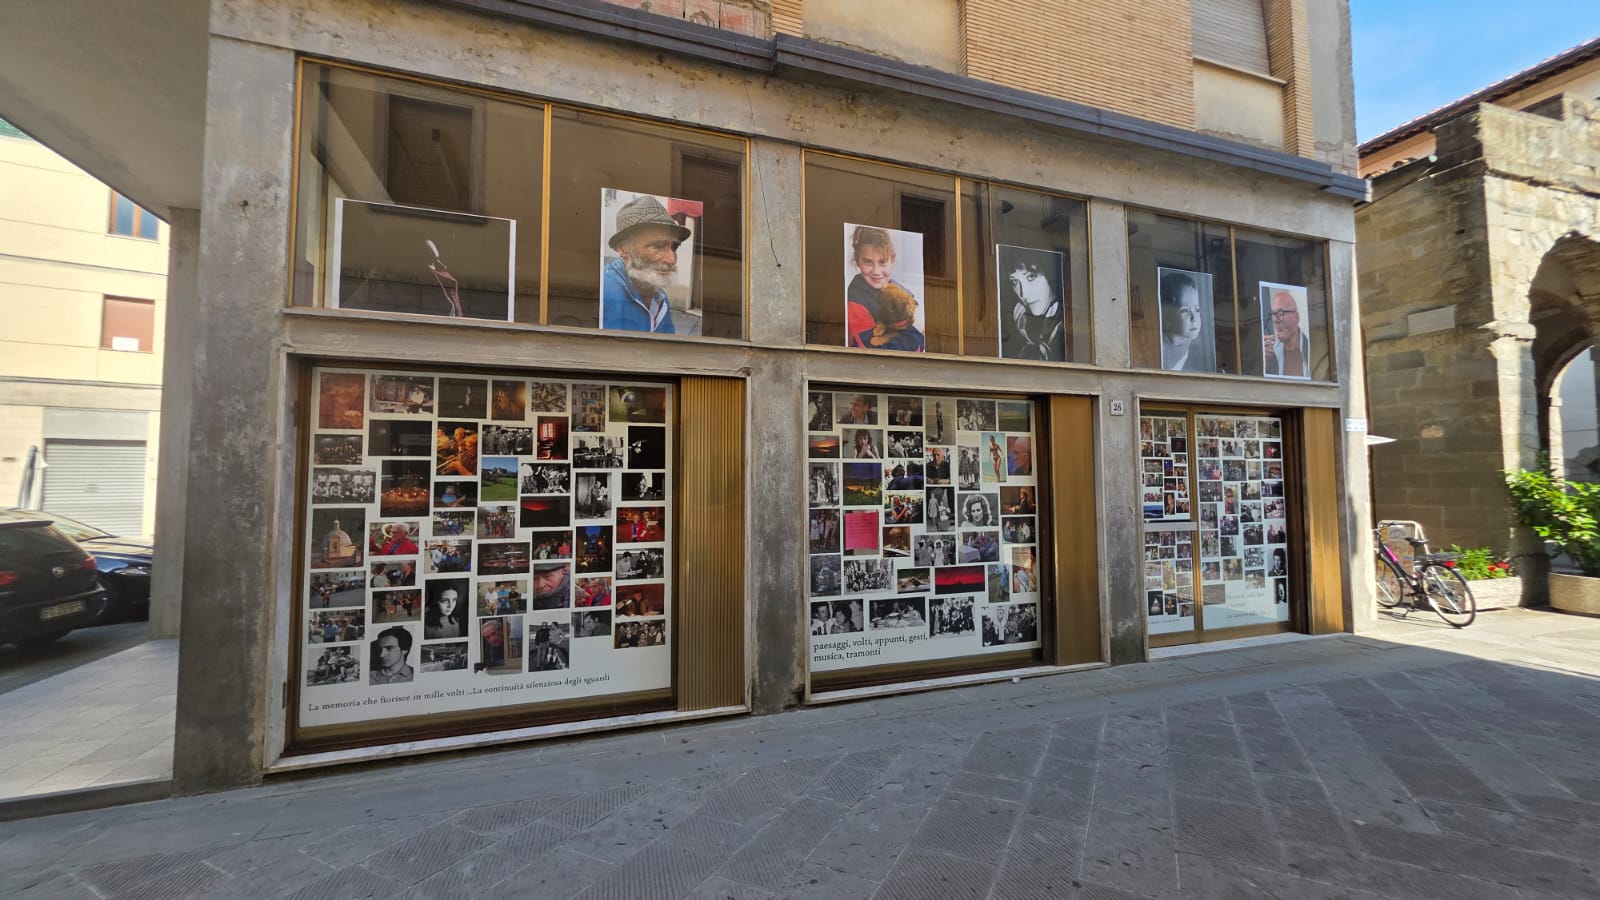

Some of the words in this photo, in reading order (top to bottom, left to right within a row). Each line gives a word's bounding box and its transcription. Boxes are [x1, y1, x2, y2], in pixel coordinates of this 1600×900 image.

[1113, 402, 1122, 412] 26
[813, 639, 851, 653] paesaggi,
[852, 636, 873, 647] volti,
[874, 634, 907, 647] appunti,
[908, 632, 928, 644] gesti,
[813, 651, 845, 662] musica,
[846, 647, 881, 659] tramonti
[308, 703, 319, 712] La
[322, 699, 361, 710] memoria
[363, 697, 378, 706] che
[380, 694, 411, 704] fiorisce
[413, 691, 422, 701] in
[424, 689, 445, 700] mille
[446, 687, 465, 698] volti
[484, 682, 524, 694] continuità
[526, 678, 562, 689] silenziosa
[564, 676, 582, 688] degli
[583, 673, 610, 685] sguardi
